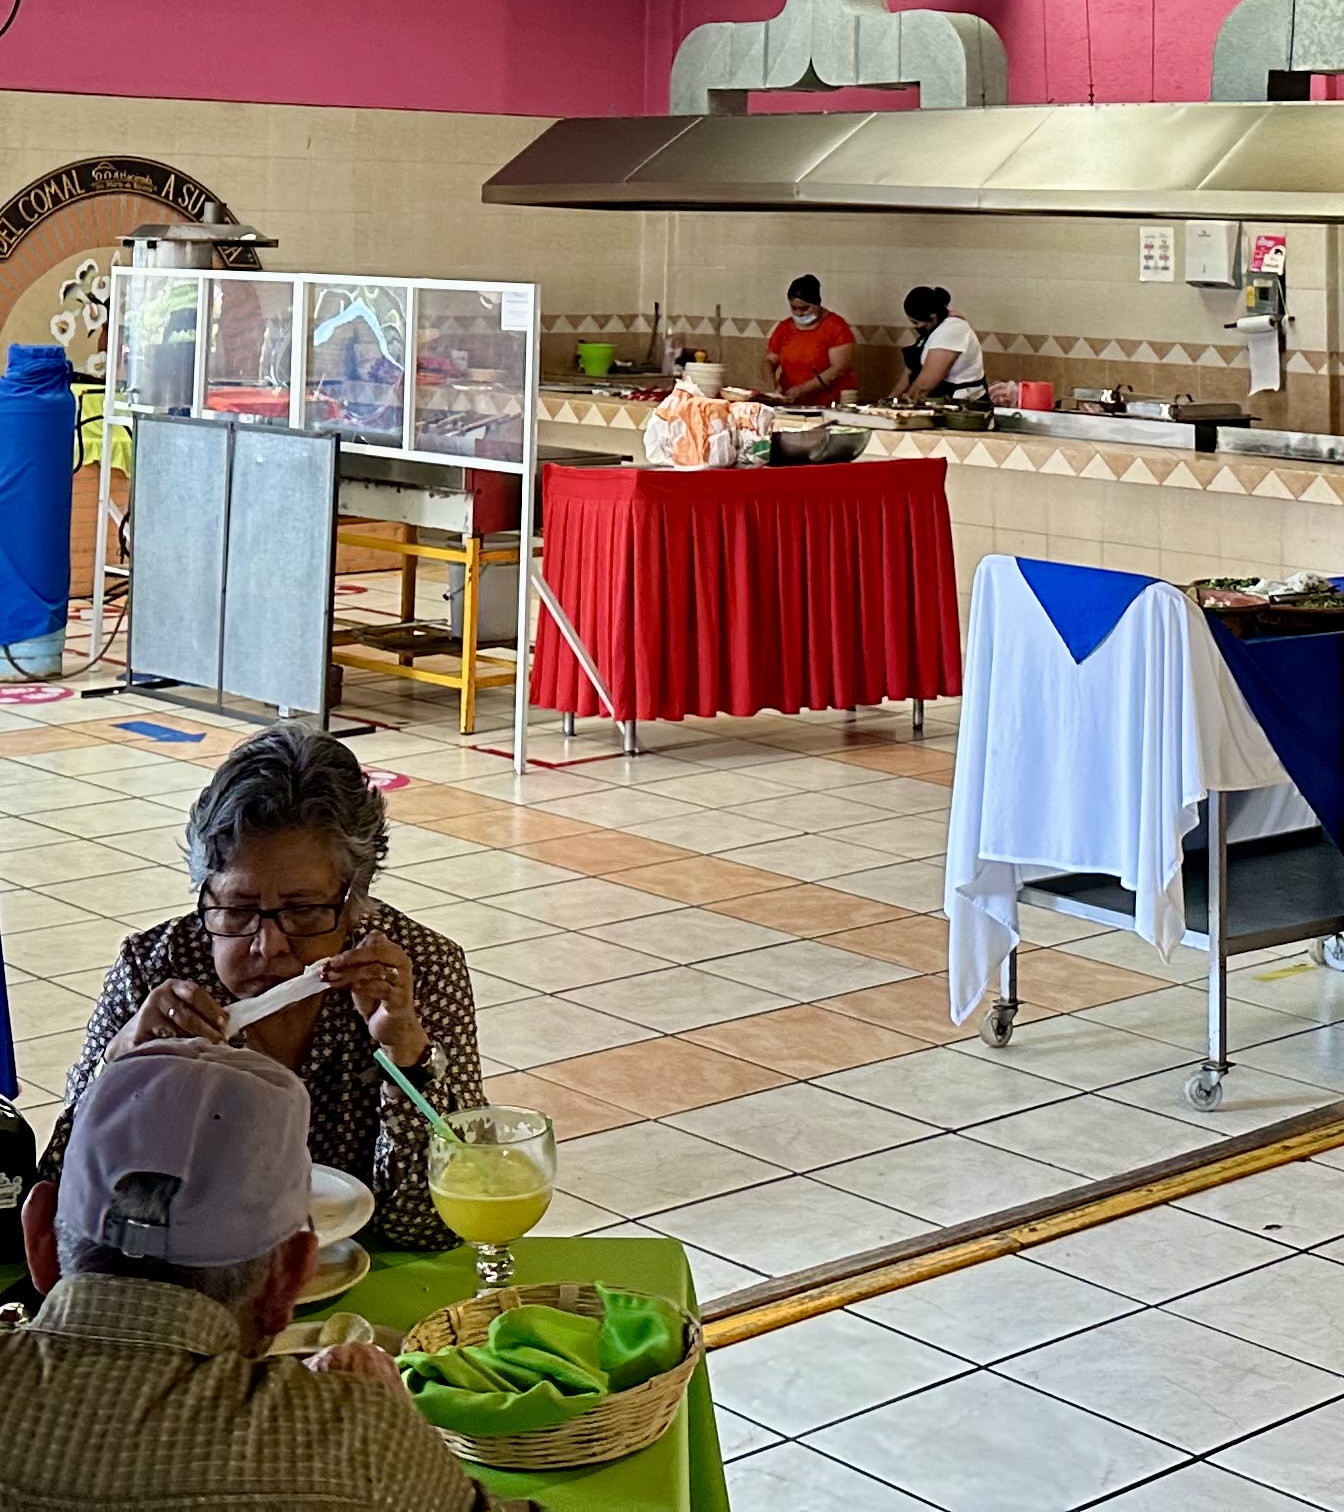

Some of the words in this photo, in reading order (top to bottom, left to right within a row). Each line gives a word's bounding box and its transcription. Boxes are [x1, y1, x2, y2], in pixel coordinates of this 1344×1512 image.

[18, 169, 86, 223] COMAL
[160, 173, 176, 202] A
[177, 183, 206, 215] SU
